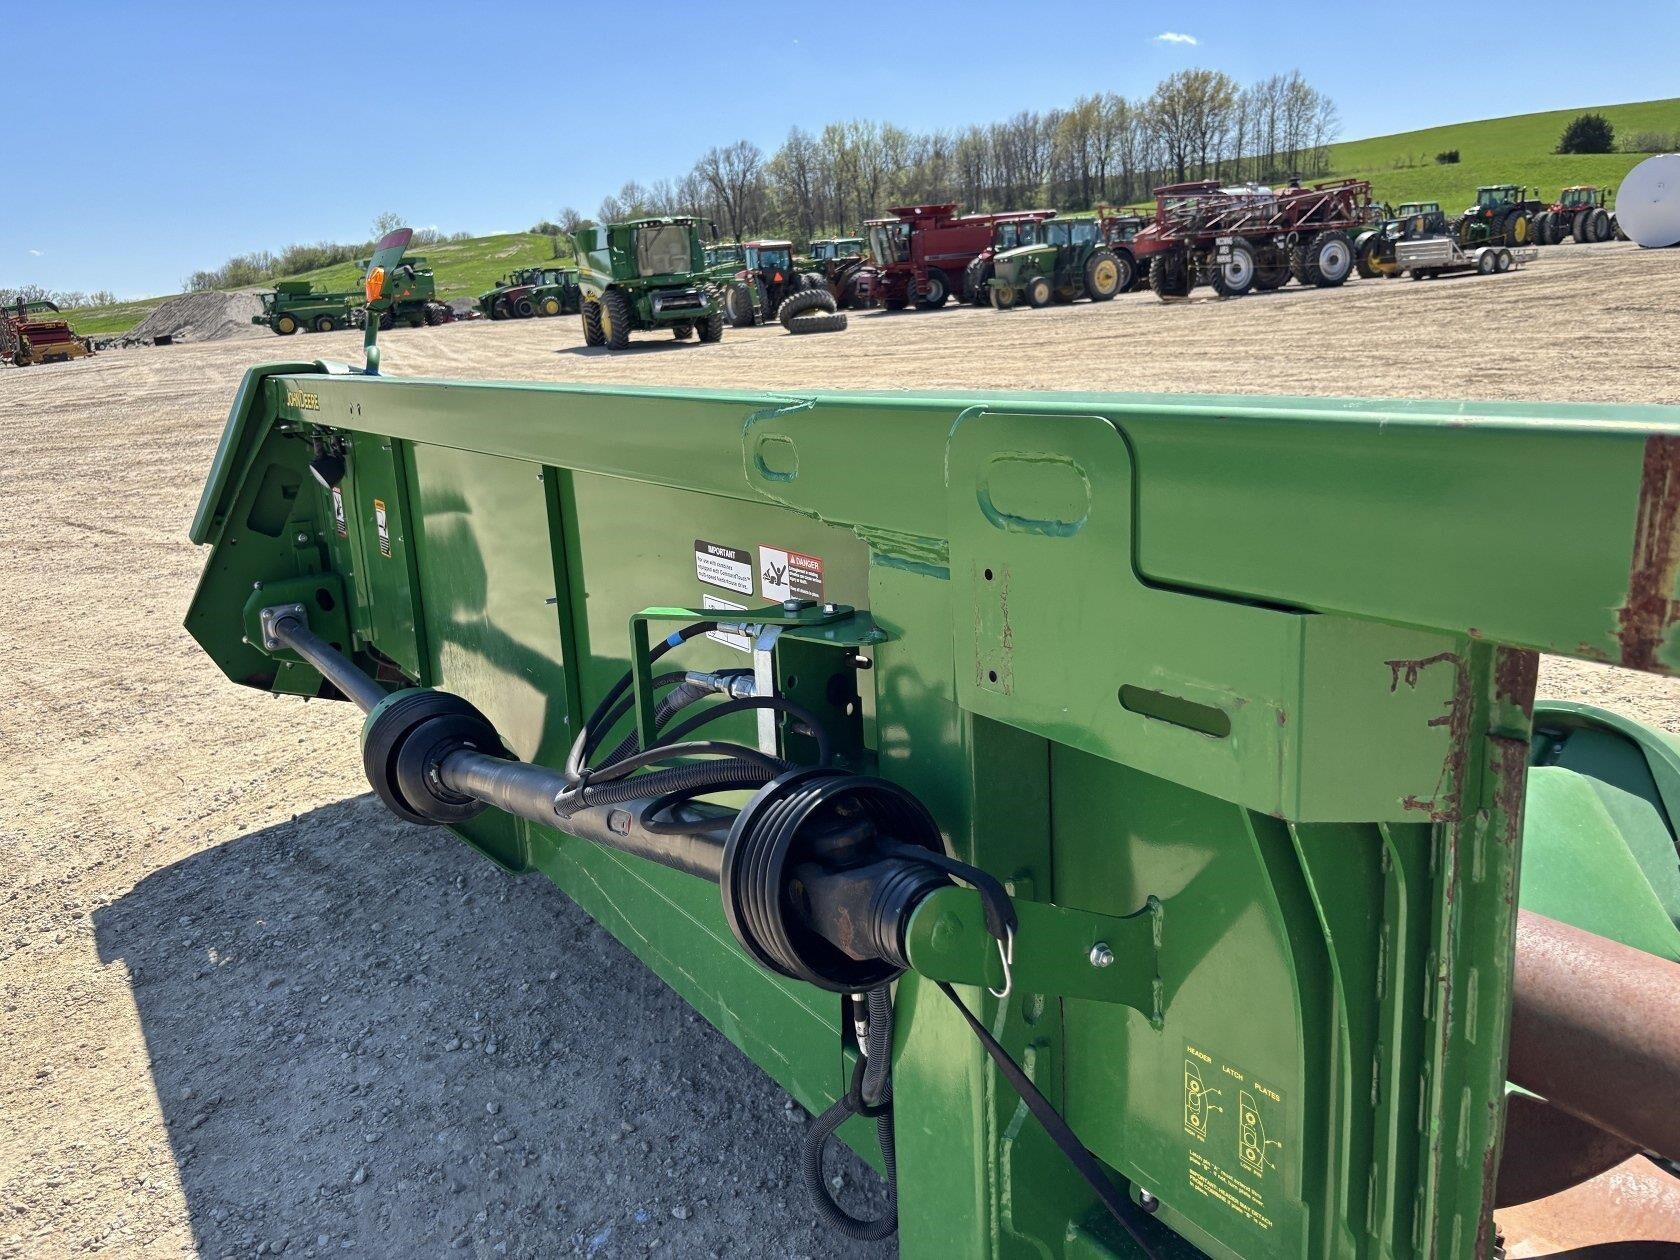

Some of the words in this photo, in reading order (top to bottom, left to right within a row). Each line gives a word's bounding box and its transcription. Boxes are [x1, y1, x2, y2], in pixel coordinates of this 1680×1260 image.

[708, 546, 735, 559] IMPORTANT
[796, 557, 818, 569] DANGER
[1187, 1046, 1211, 1063] HEADER
[1222, 1065, 1243, 1081] LATCH
[1254, 1082, 1280, 1102] PLATES
